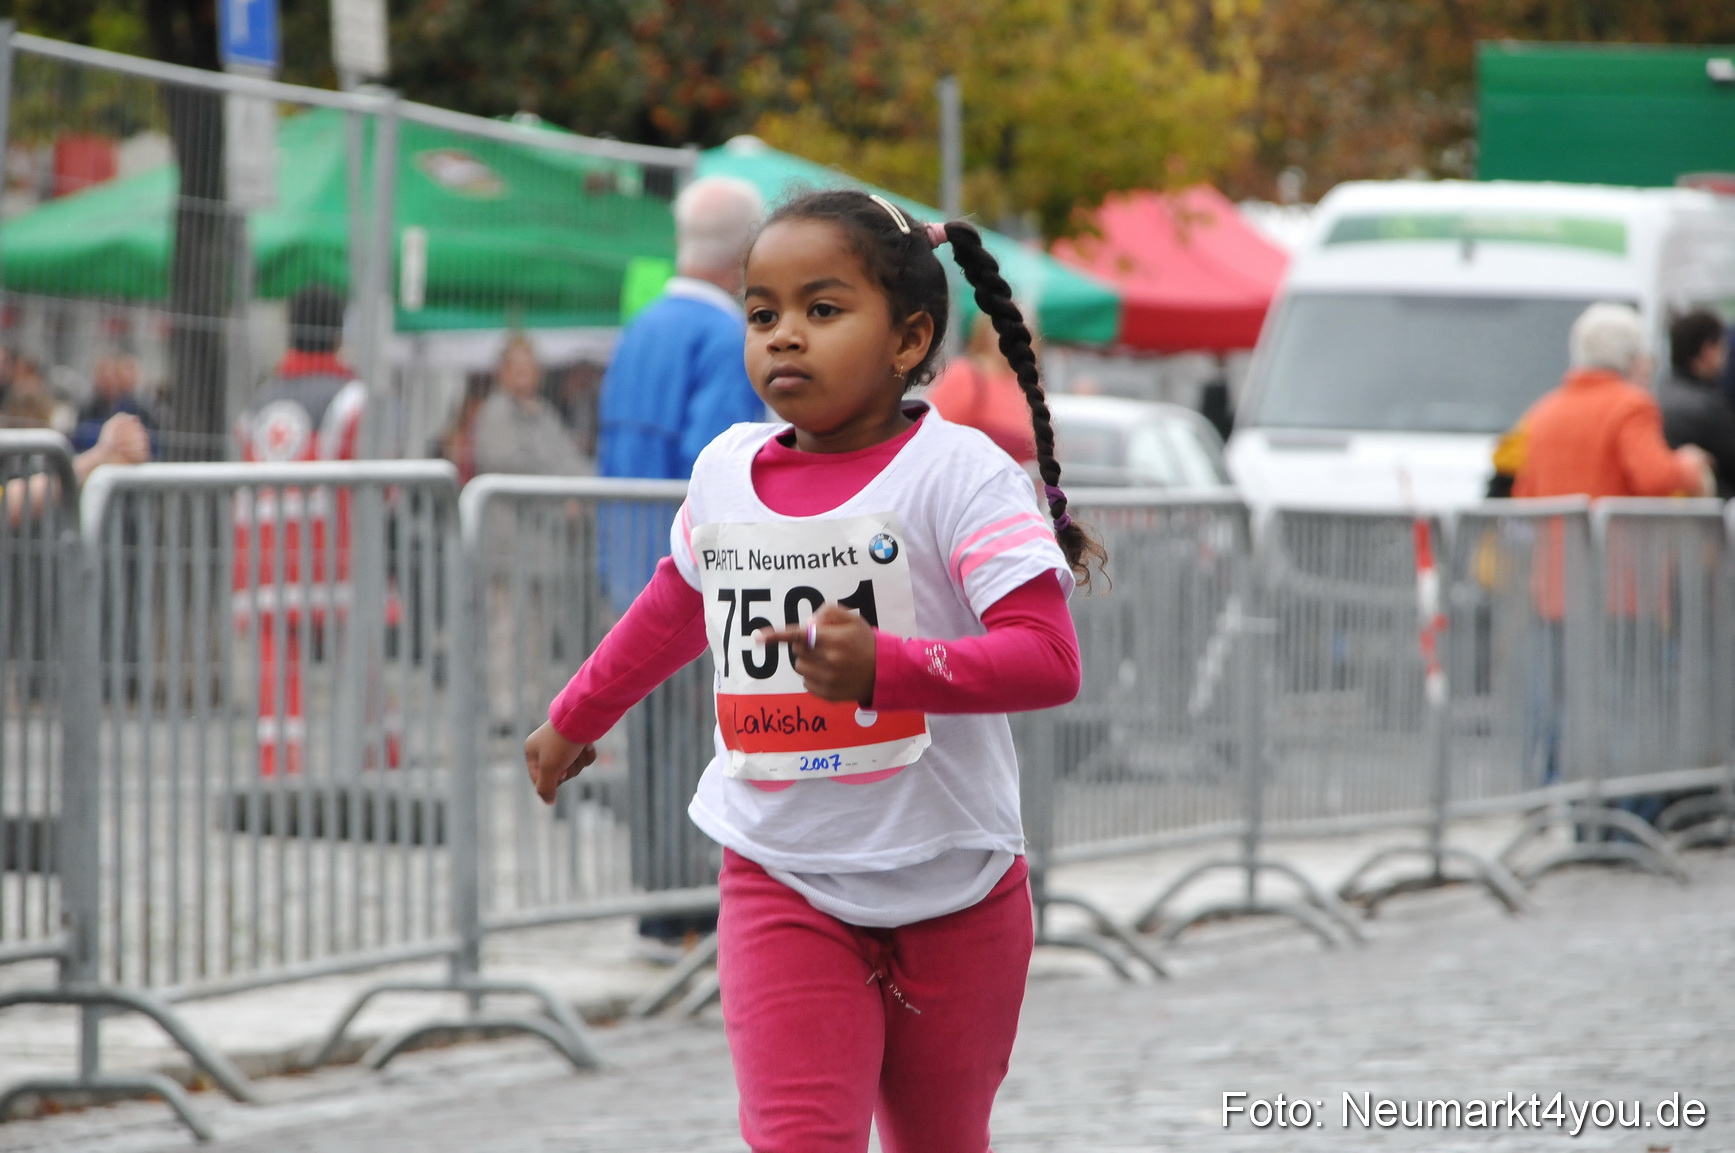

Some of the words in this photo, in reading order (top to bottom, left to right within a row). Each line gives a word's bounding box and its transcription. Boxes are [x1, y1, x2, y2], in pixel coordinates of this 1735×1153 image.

[703, 549, 743, 571] PARTL
[749, 546, 858, 571] Neumarkt
[733, 703, 827, 735] Lakisha
[799, 754, 842, 771] 2007
